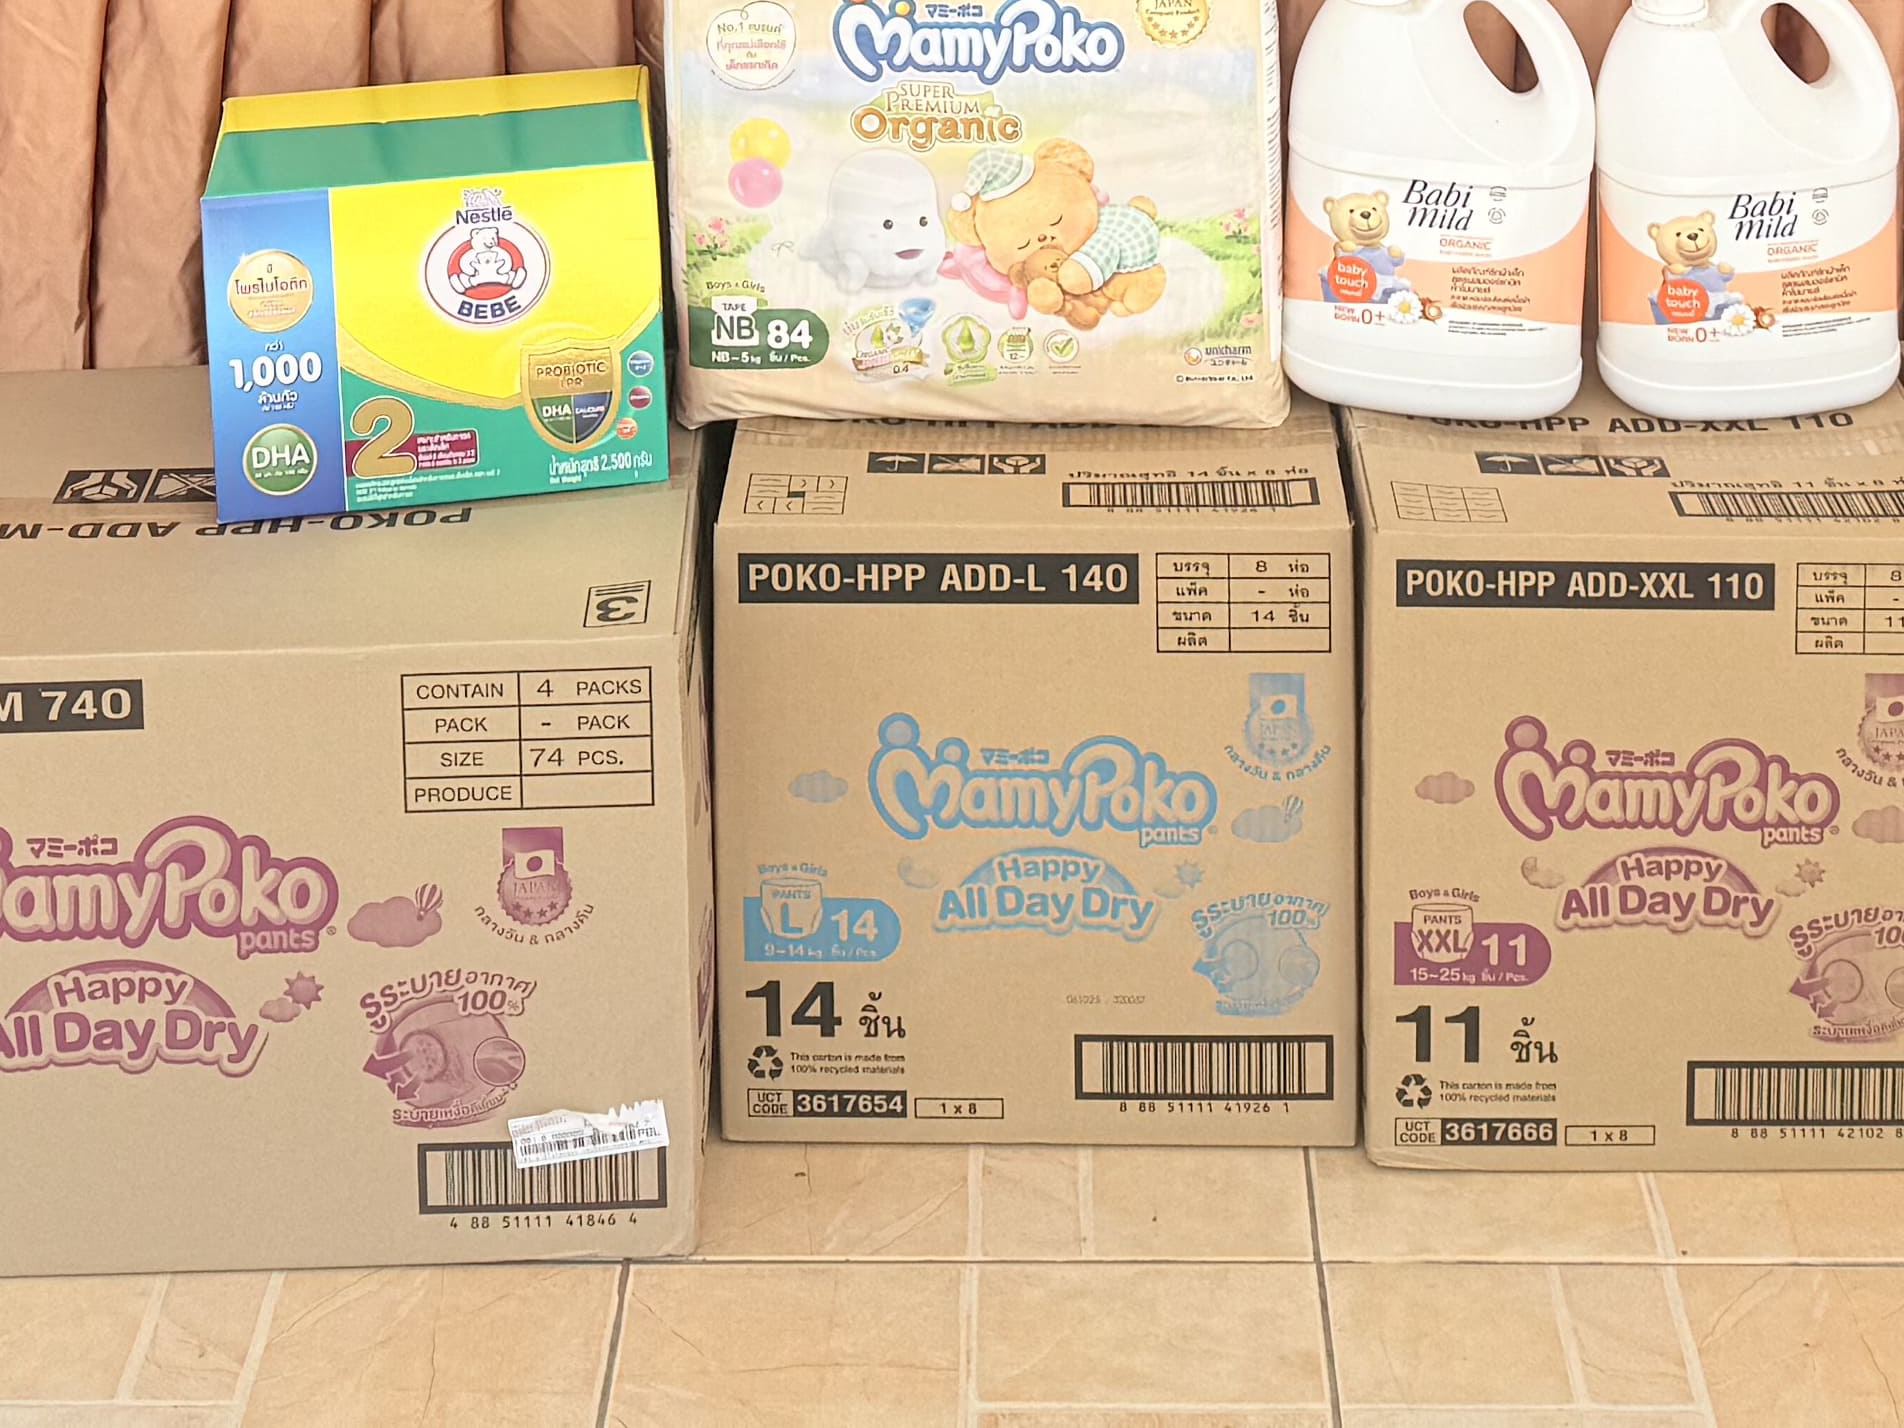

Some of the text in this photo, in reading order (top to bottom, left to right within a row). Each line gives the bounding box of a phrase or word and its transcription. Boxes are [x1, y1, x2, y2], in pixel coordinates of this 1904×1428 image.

[925, 2, 984, 18] マミーポコ
[899, 83, 955, 99] SUPER
[886, 92, 981, 114] PREMIUM
[853, 107, 1022, 148] Organic
[1402, 179, 1474, 208] Babi
[1729, 191, 1796, 220] Babi
[1440, 238, 1492, 251] ORGANIC
[1767, 244, 1818, 256] ORGANIC
[1335, 275, 1368, 289] touch
[1337, 262, 1368, 279] baby
[1667, 285, 1698, 297] baby
[457, 296, 521, 319] BEBE
[722, 303, 746, 311] TAPE
[1666, 297, 1701, 309] touch
[716, 316, 813, 350] NB 84
[229, 352, 322, 392] 1,000
[536, 361, 607, 377] PROBIOTIC
[351, 396, 416, 478] 2
[252, 441, 311, 468] DHA
[747, 563, 1129, 592] POKO-HPP ADD-L 140
[1406, 570, 1764, 599] POKO-HPP ADD-XXL 110
[416, 679, 642, 700] CONTAIN 4 PACKS
[40, 687, 134, 725] 740
[435, 715, 631, 733] PACK PACK
[440, 748, 624, 767] SIZE 74 PCS.
[415, 786, 512, 802] PRODUCE
[997, 859, 1101, 883] Happy
[1620, 857, 1724, 883] Happy
[1561, 885, 1775, 924] All Day Dry
[1417, 929, 1526, 966] XXL 11
[52, 972, 188, 1007] Happy
[746, 980, 906, 1038] 14 ชิ้น
[65, 1013, 155, 1063] Day
[164, 1017, 260, 1068] Dry
[1396, 1005, 1558, 1063] 11 ชิ้น
[797, 1096, 904, 1113] 3617654
[1446, 1124, 1553, 1140] 3617666
